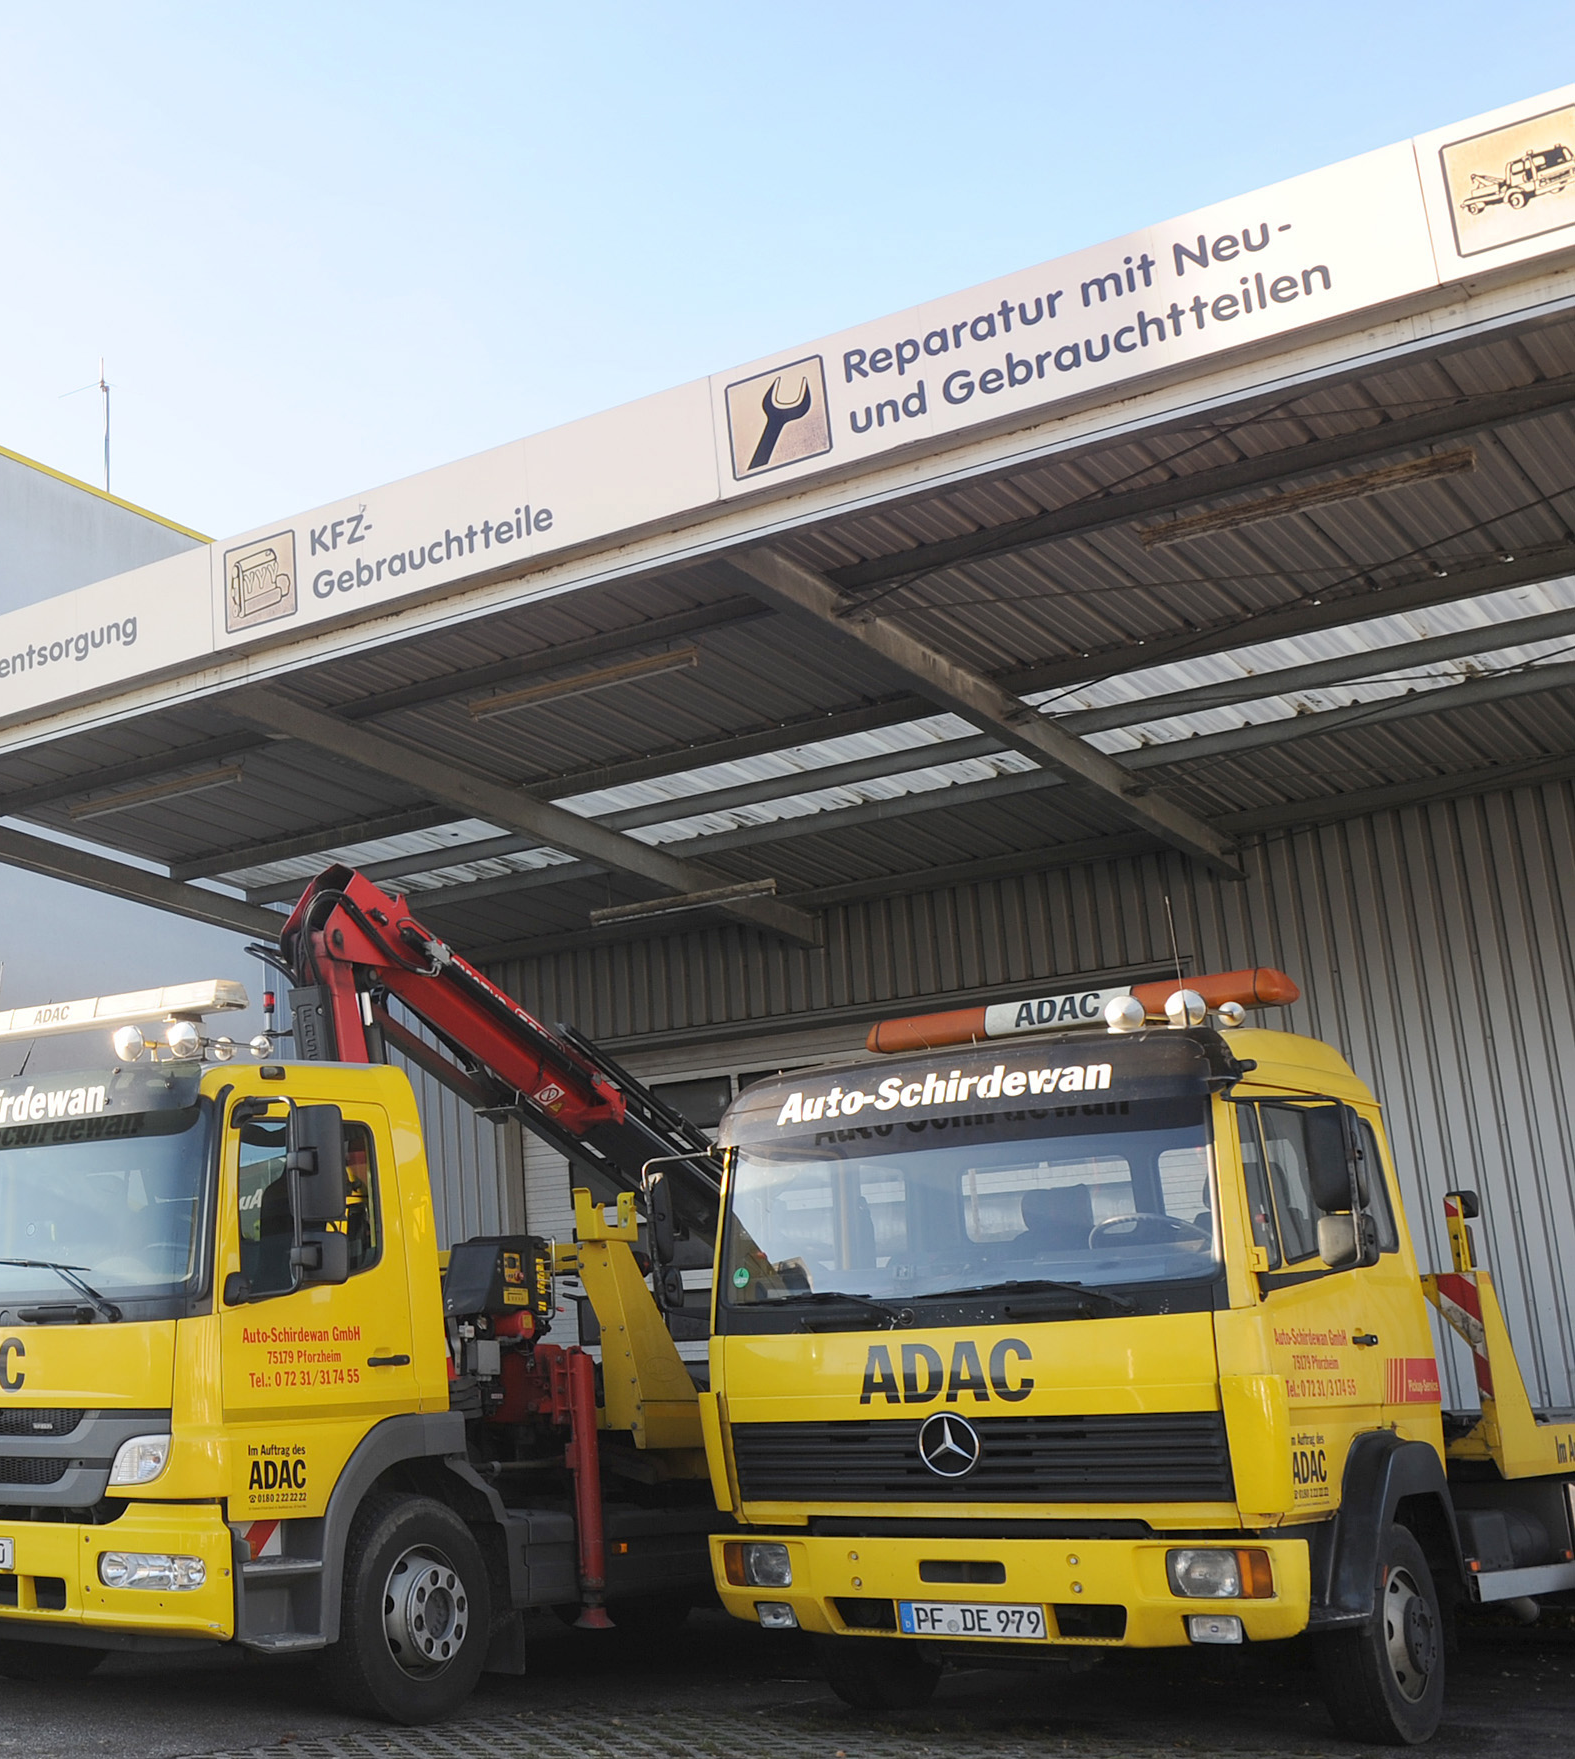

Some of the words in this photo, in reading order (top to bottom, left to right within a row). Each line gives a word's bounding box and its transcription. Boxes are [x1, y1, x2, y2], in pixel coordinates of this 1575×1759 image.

[843, 290, 1063, 383] Reparatur
[1081, 253, 1155, 308] mit
[1172, 222, 1292, 277] Neu-
[849, 379, 928, 434] und
[942, 264, 1332, 405] Gebrauchtteilen
[309, 512, 373, 557] KFZ-
[312, 504, 555, 600] Gebrauchtteile
[33, 1005, 71, 1025] ADAC
[1014, 992, 1101, 1028] ADAC
[776, 1062, 1113, 1127] Auto-Schirdewan
[242, 1326, 330, 1344] Auto-Schirdewan
[332, 1325, 361, 1342] GmbH
[1273, 1328, 1328, 1346] Auto-Schirdewan
[1328, 1329, 1348, 1346] GmbH
[267, 1350, 294, 1365] 75179
[297, 1349, 342, 1364] Pforzheim
[859, 1337, 1035, 1405] ADAC
[1292, 1354, 1311, 1370] 75179
[249, 1372, 272, 1388] Tel.:
[274, 1371, 282, 1387] 0
[284, 1370, 297, 1387] 72
[333, 1369, 344, 1384] 74
[347, 1368, 360, 1384] 55
[1301, 1379, 1306, 1397] 0
[1307, 1379, 1316, 1397] 72
[248, 1444, 258, 1456] Im
[261, 1444, 290, 1457] Auftrag
[292, 1443, 306, 1455] des
[1555, 1435, 1568, 1464] Im
[249, 1459, 307, 1490] ADAC
[1293, 1449, 1327, 1485] ADAC
[914, 1607, 943, 1631] PF
[960, 1608, 992, 1632] DE
[996, 1610, 1041, 1634] 979
